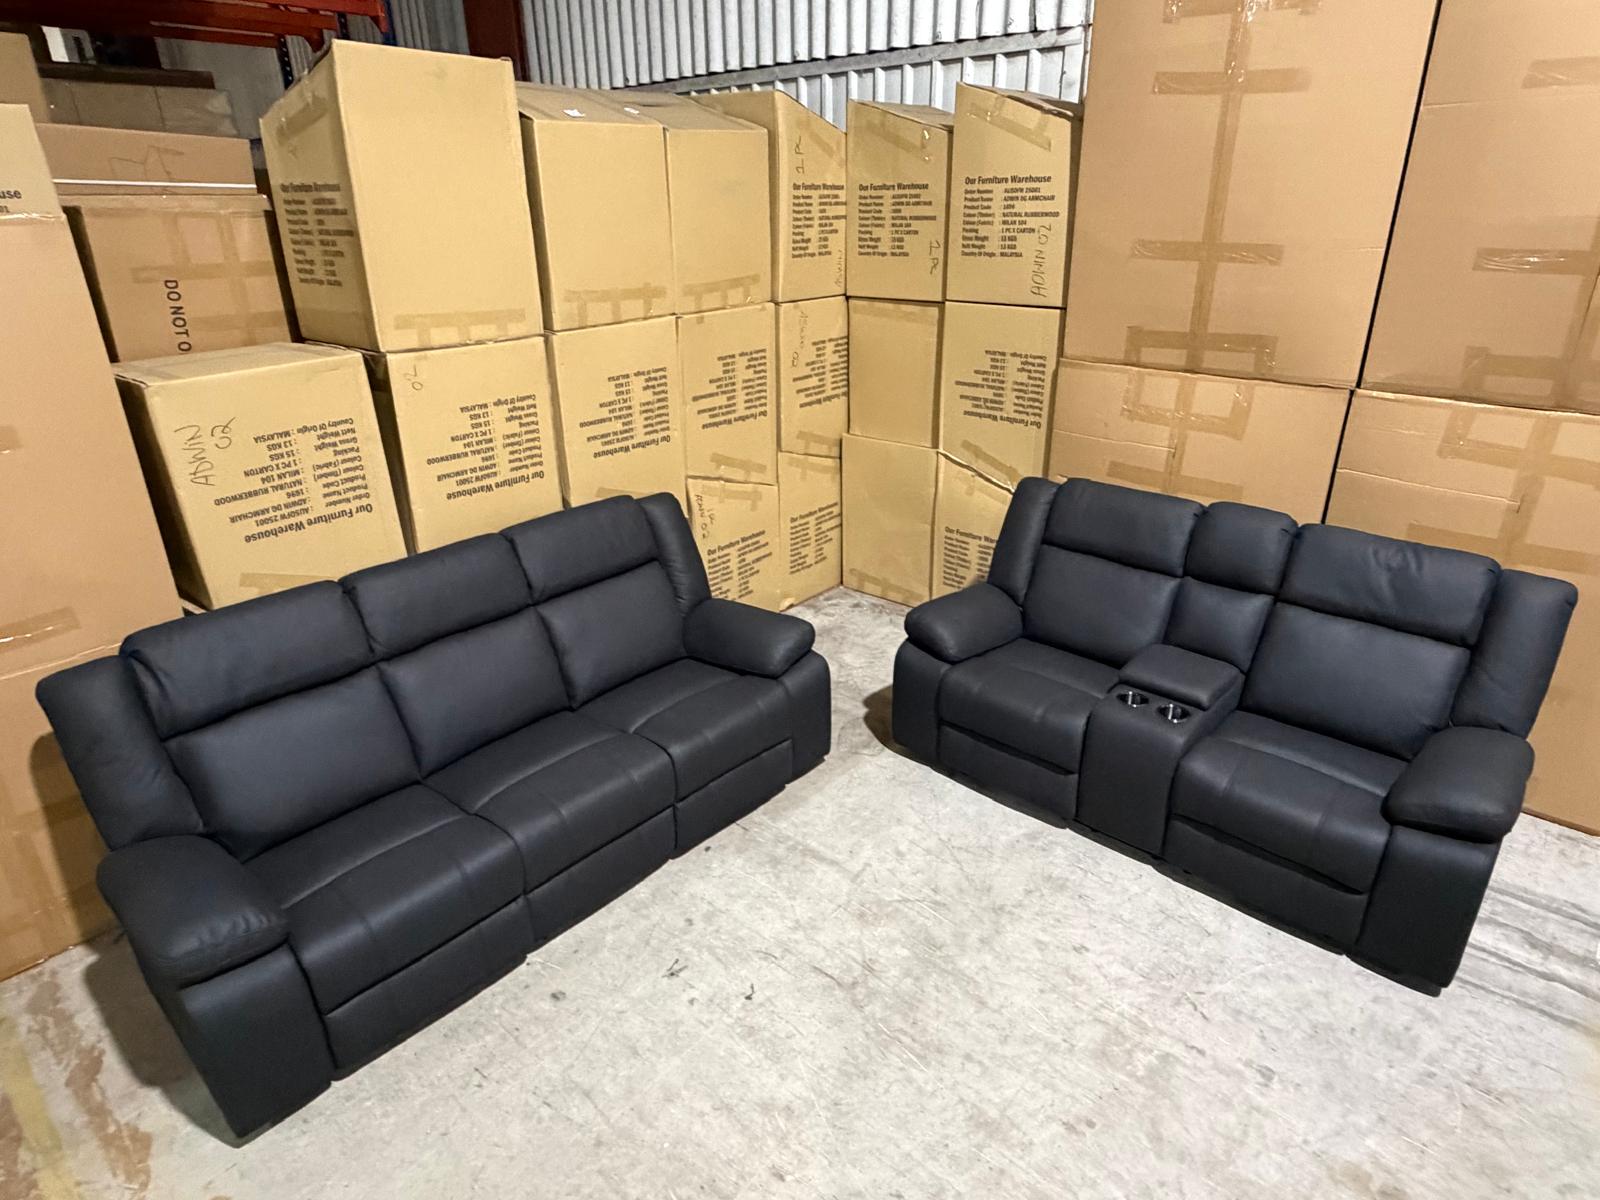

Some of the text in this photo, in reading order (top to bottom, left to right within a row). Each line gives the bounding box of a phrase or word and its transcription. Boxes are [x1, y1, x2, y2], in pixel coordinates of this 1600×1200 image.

[965, 175, 1051, 185] Our Furniture Warehouse
[164, 280, 182, 302] DO
[169, 306, 190, 338] NOT
[253, 417, 353, 444] Country Of Origin MALAYSIA
[267, 428, 355, 451] Nett Weight 13 KGS
[269, 437, 357, 461] Gross Weight 15 KGS
[333, 447, 359, 457] Packing
[593, 435, 670, 458] Our Furniture Warehouse
[244, 465, 273, 477] CARTON
[261, 455, 361, 484] Colour (Fabric) MILAN 104
[281, 460, 291, 468] PC
[214, 464, 363, 506] Colour (Timber) NATURAL RUBBERWOOD
[322, 479, 339, 489] Code
[341, 473, 366, 483] Product
[229, 483, 367, 523] Product Name ADWIN DG ARMCHAIR
[325, 497, 351, 507] Number
[352, 492, 370, 500] Order
[244, 503, 372, 544] Our Furniture Warehouse
